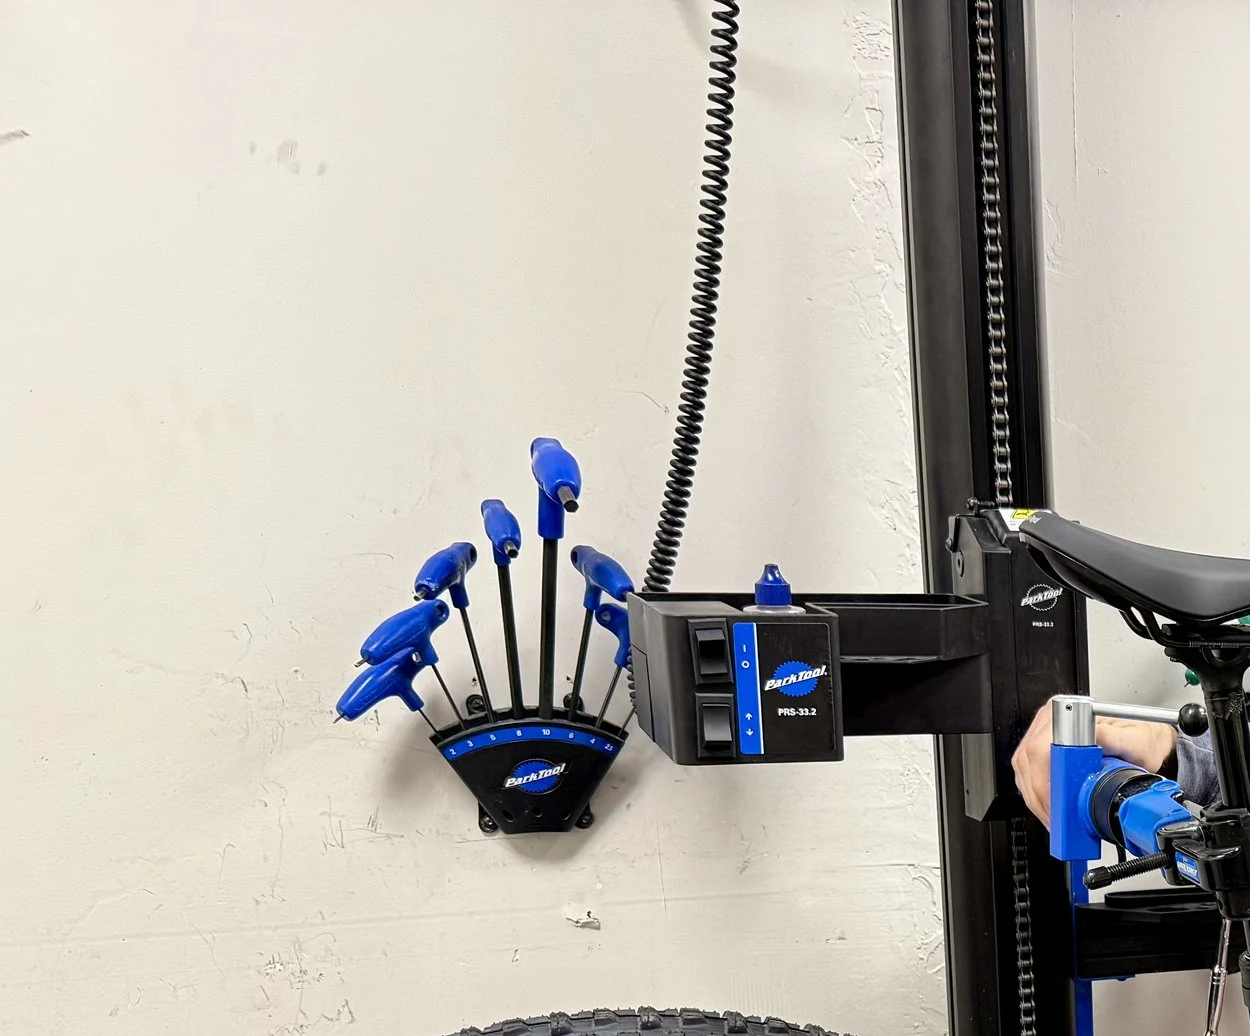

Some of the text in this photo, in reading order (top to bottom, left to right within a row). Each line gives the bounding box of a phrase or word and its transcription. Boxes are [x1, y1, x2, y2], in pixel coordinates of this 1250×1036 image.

[1020, 588, 1064, 607] ParkTool
[764, 664, 828, 692] ParkTool
[778, 708, 817, 716] PRS-33.2
[449, 748, 456, 756] 2
[467, 740, 474, 748] 3
[504, 762, 567, 788] ParkTool
